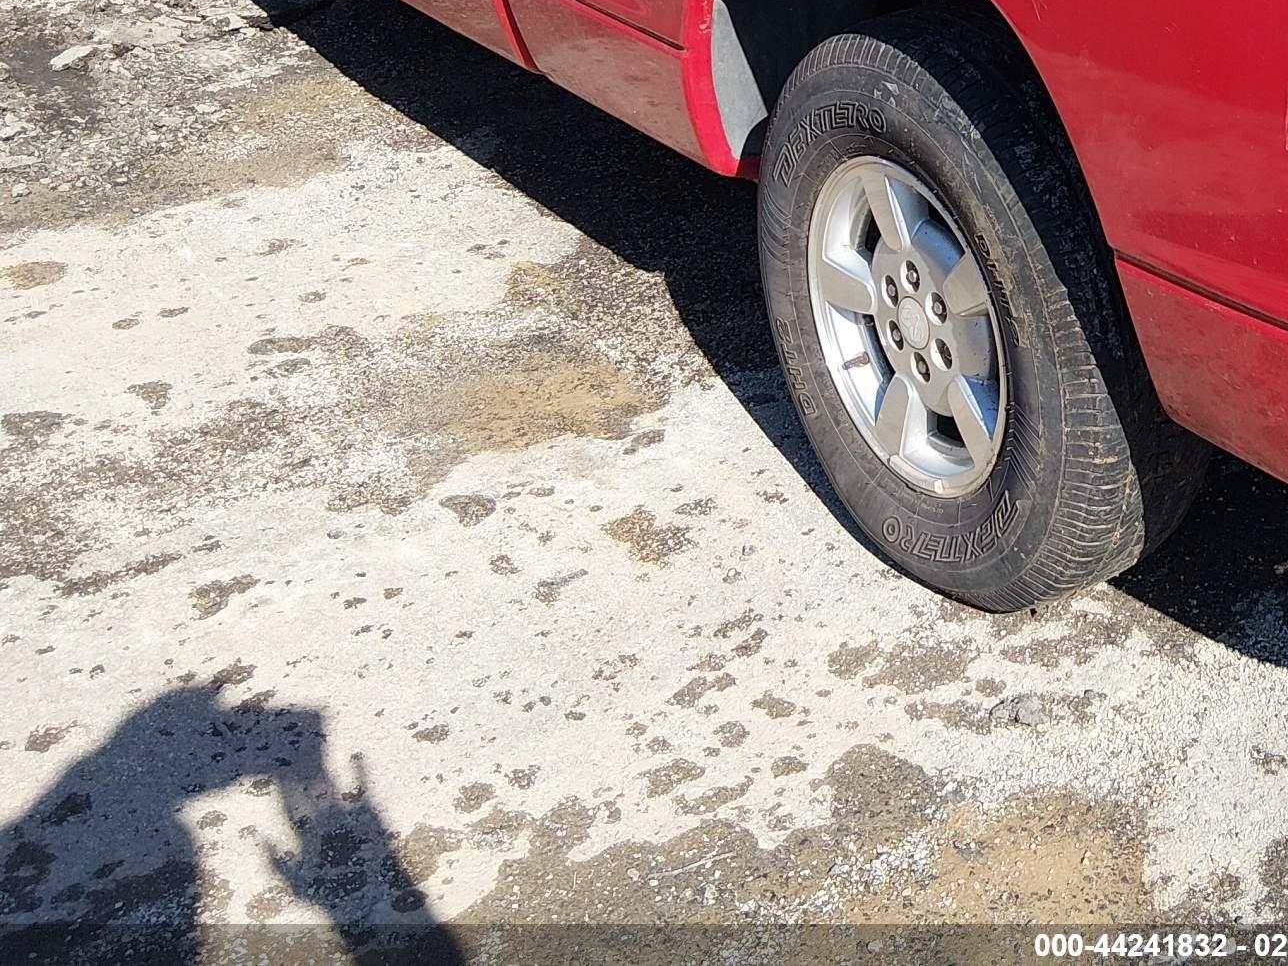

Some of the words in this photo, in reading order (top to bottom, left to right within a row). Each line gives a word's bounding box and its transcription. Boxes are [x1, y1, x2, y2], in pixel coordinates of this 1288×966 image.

[772, 100, 887, 187] DEXTERO
[775, 316, 817, 416] DHT2
[882, 489, 1020, 563] DEXTERO
